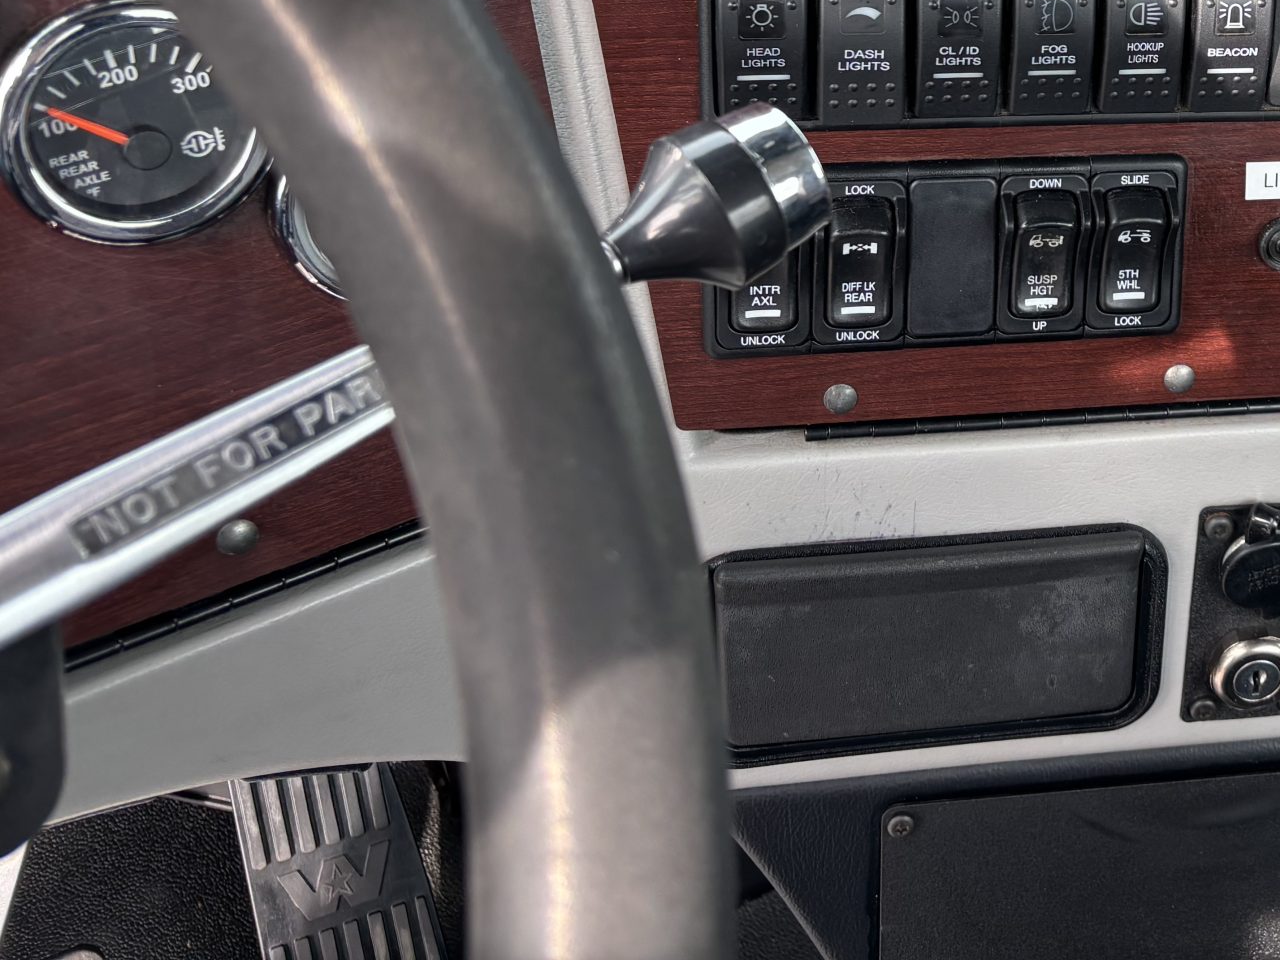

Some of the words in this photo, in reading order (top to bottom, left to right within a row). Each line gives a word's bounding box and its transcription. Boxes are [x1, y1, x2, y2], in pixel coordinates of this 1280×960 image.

[746, 47, 781, 57] HEAD
[1040, 44, 1068, 55] FOG
[1126, 42, 1165, 52] HOOKUP
[1207, 47, 1259, 58] BEACON
[844, 49, 885, 60] DASH
[1031, 54, 1076, 66] LIGHTS
[1128, 53, 1159, 64] LIGHTS
[741, 57, 786, 69] LIGHTS
[837, 60, 890, 72] LIGHTS
[935, 56, 982, 67] LIGHTS
[98, 65, 138, 88] 200
[170, 71, 211, 94] 300
[48, 150, 90, 168] REAR
[59, 161, 99, 179] REAR
[74, 171, 112, 189] AXLE
[1029, 178, 1062, 190] DOWN
[1120, 174, 1150, 185] SLIDE
[845, 184, 875, 196] LOCK
[1118, 269, 1140, 280] 5TH
[1027, 275, 1058, 286] SUSP
[1116, 279, 1141, 290] WHL
[749, 285, 781, 296] INTR
[841, 282, 863, 293] DIFF
[863, 281, 877, 292] LK
[1030, 285, 1054, 296] HGT
[751, 296, 777, 307] AXL
[844, 292, 873, 303] REAR
[1032, 321, 1047, 332] UP
[1114, 315, 1142, 327] LOCK
[740, 334, 786, 346] UNLOCK
[836, 330, 880, 342] UNLOCK
[88, 475, 181, 544] NOT
[192, 424, 288, 489] FOR
[292, 375, 384, 436] PAR
